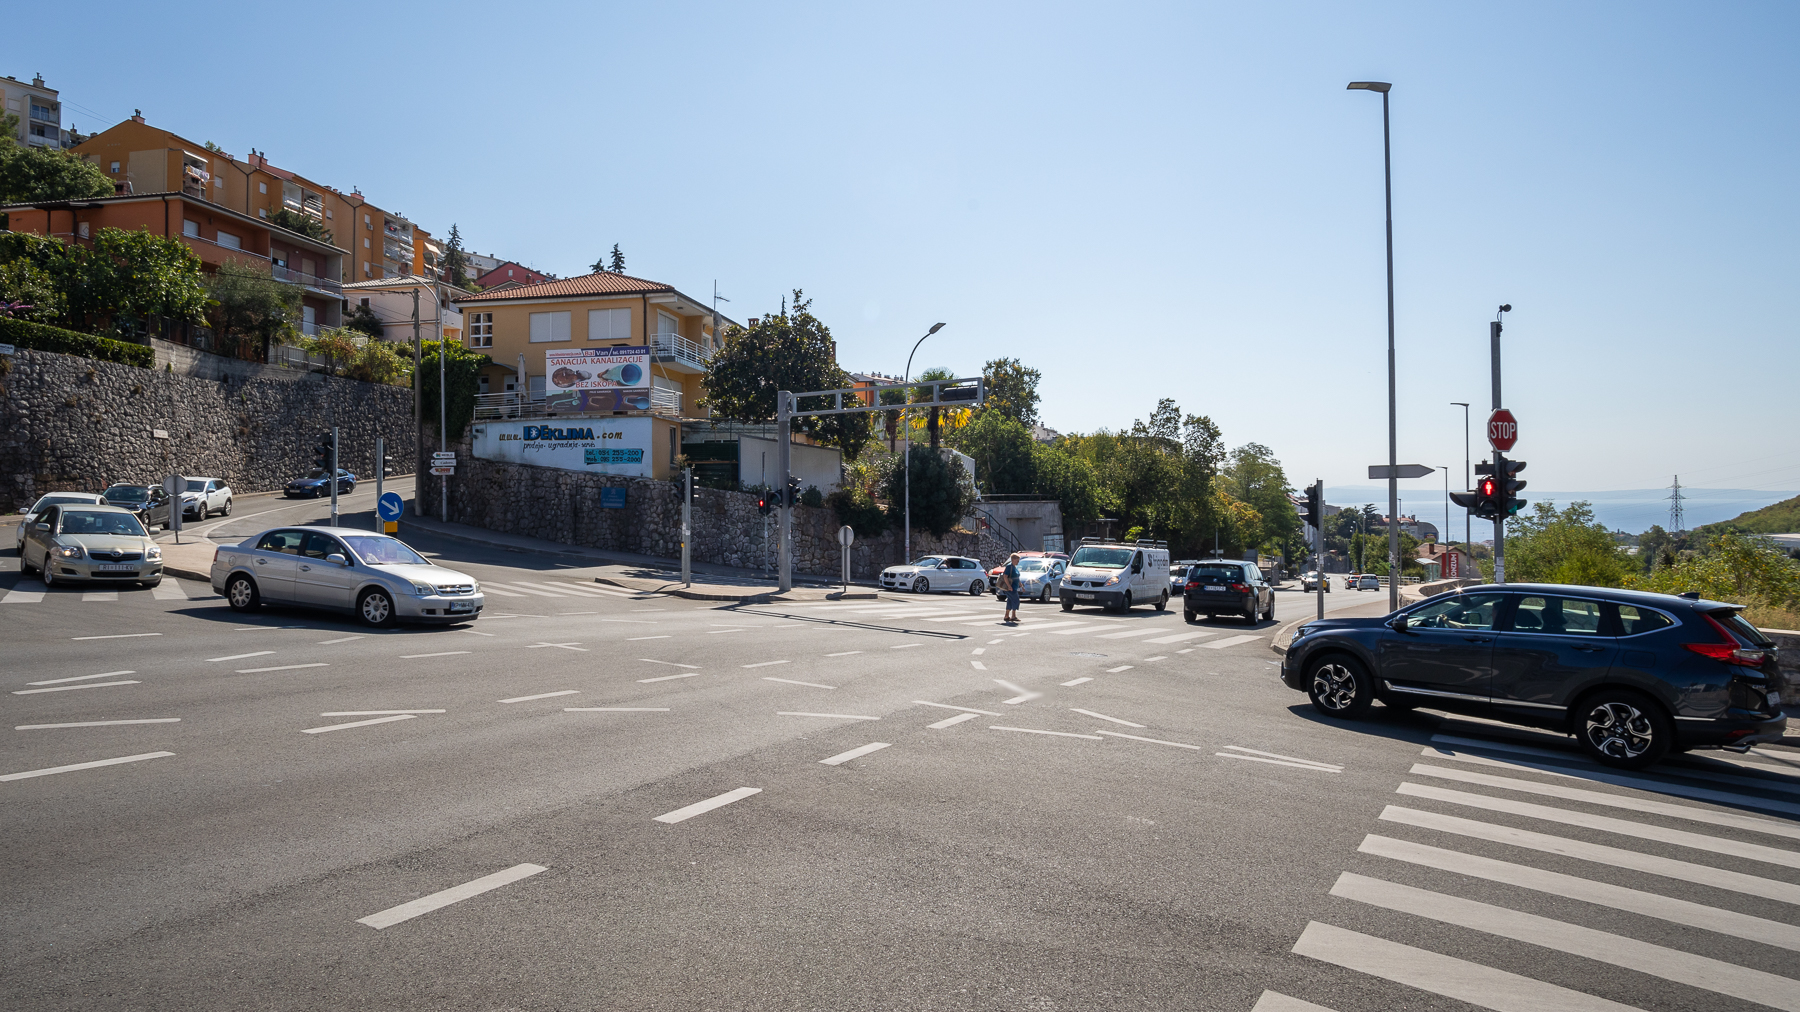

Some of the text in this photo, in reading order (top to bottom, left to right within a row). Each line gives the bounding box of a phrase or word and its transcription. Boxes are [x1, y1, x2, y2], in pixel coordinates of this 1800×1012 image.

[551, 356, 643, 366] SANACIJA KANALIZACIJE
[1491, 422, 1515, 439] STOP
